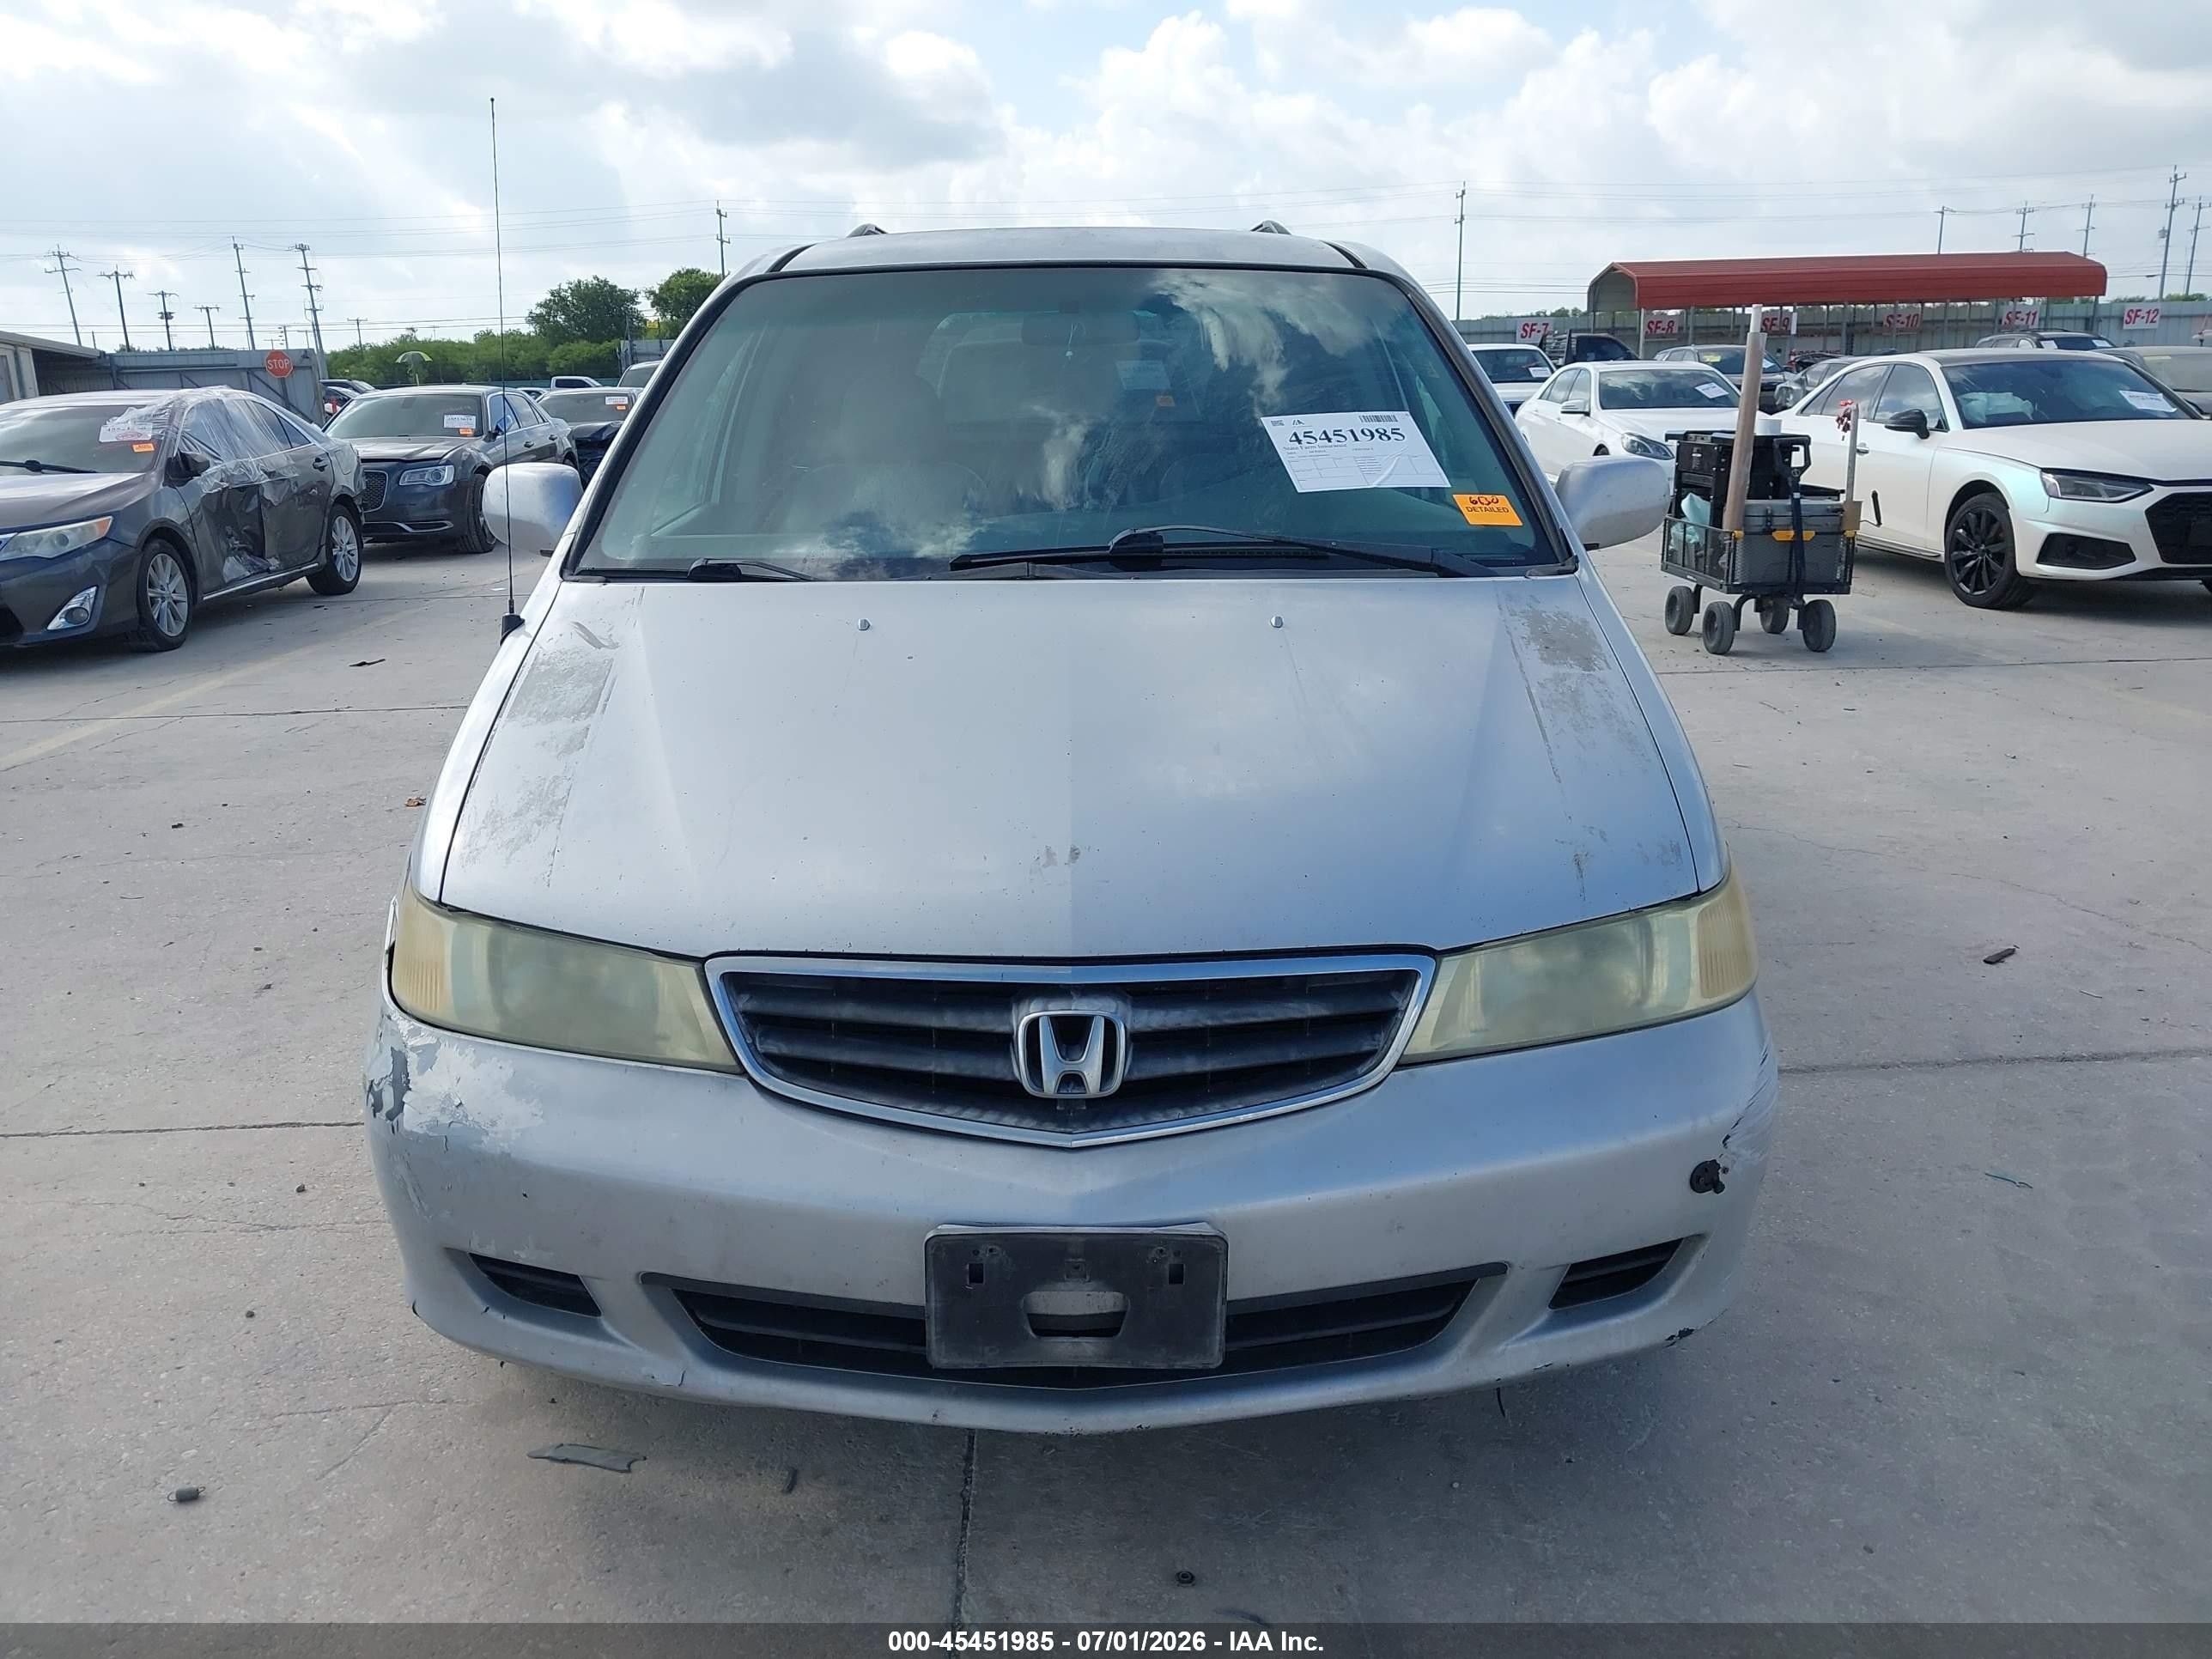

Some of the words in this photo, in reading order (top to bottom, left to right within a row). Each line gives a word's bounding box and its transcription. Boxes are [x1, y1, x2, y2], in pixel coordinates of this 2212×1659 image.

[1761, 317, 1790, 331] SF9
[2003, 310, 2038, 325] SF-11
[2124, 308, 2160, 325] SF-12
[1520, 322, 1549, 339] SF-7
[1646, 319, 1675, 334] SF-8
[267, 358, 290, 370] STOP
[1288, 427, 1406, 446] 45451985
